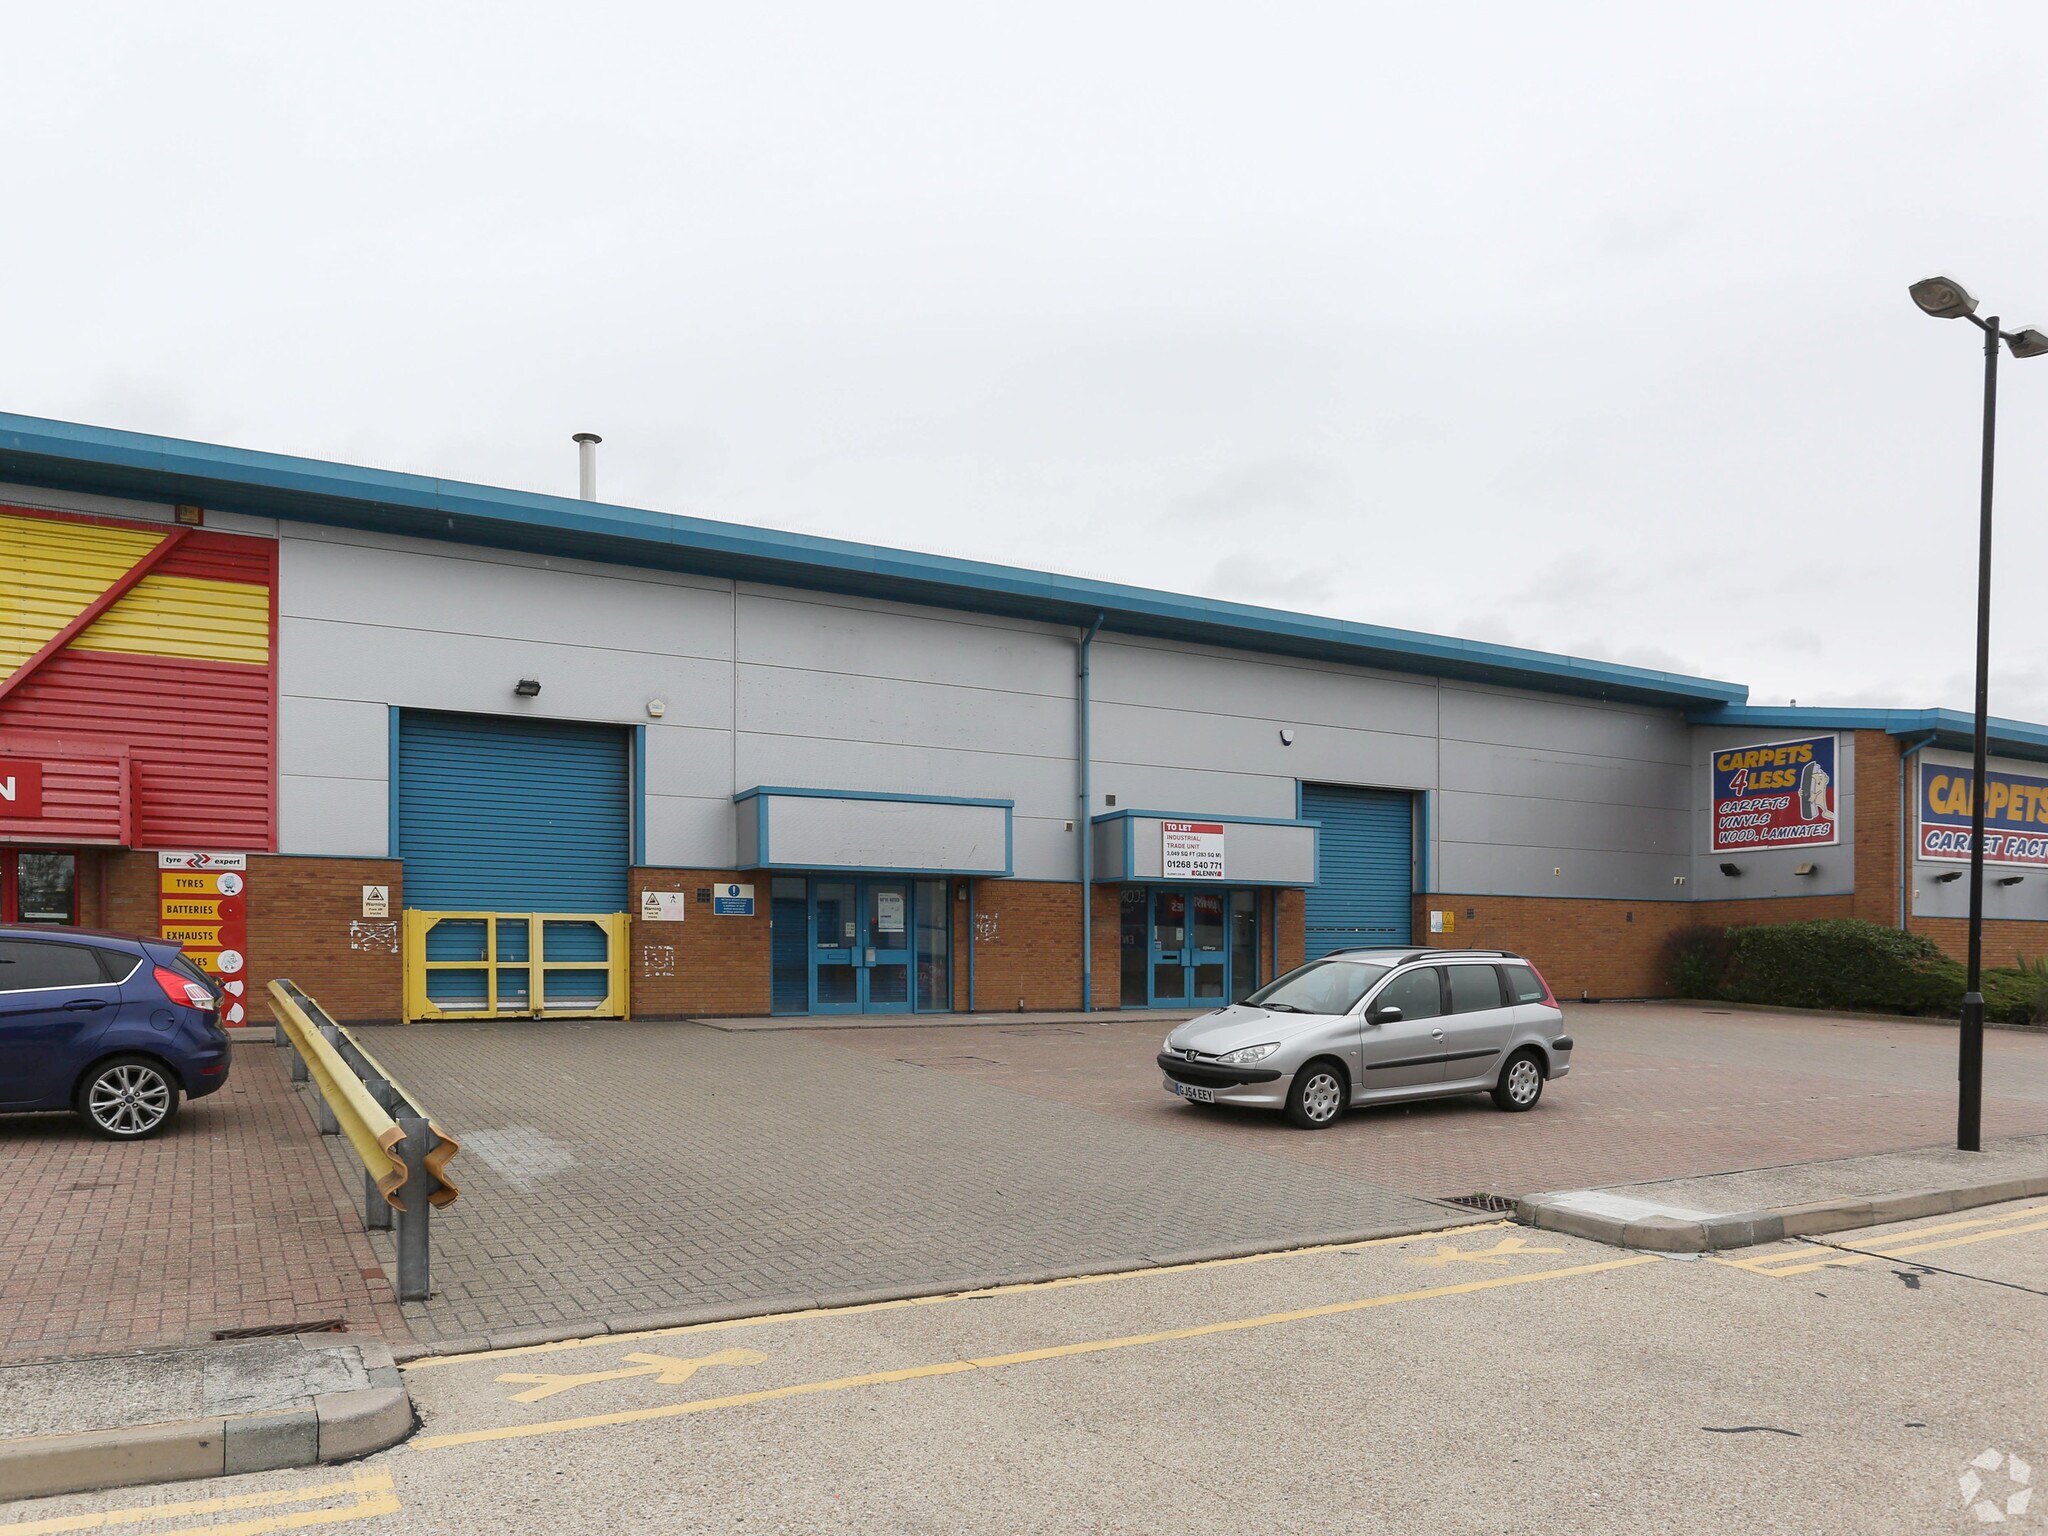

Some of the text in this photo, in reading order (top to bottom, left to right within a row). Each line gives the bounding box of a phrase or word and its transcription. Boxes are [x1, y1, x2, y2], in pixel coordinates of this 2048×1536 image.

[1717, 743, 1814, 772] CARPETS
[1729, 769, 1796, 796] 4 LESS
[1719, 796, 1791, 814] CARPETS
[1166, 823, 1177, 831] TO
[1719, 813, 1771, 828] VINYLS
[1759, 823, 1831, 840] LAMINATES
[1926, 830, 2003, 856] CARET
[1167, 860, 1222, 870] 01268 540 771
[176, 879, 204, 888] TYRES
[166, 904, 213, 914] BATTERIES
[166, 931, 214, 941] EXHAUSTS
[1179, 1085, 1212, 1101] GJ54 EEY
